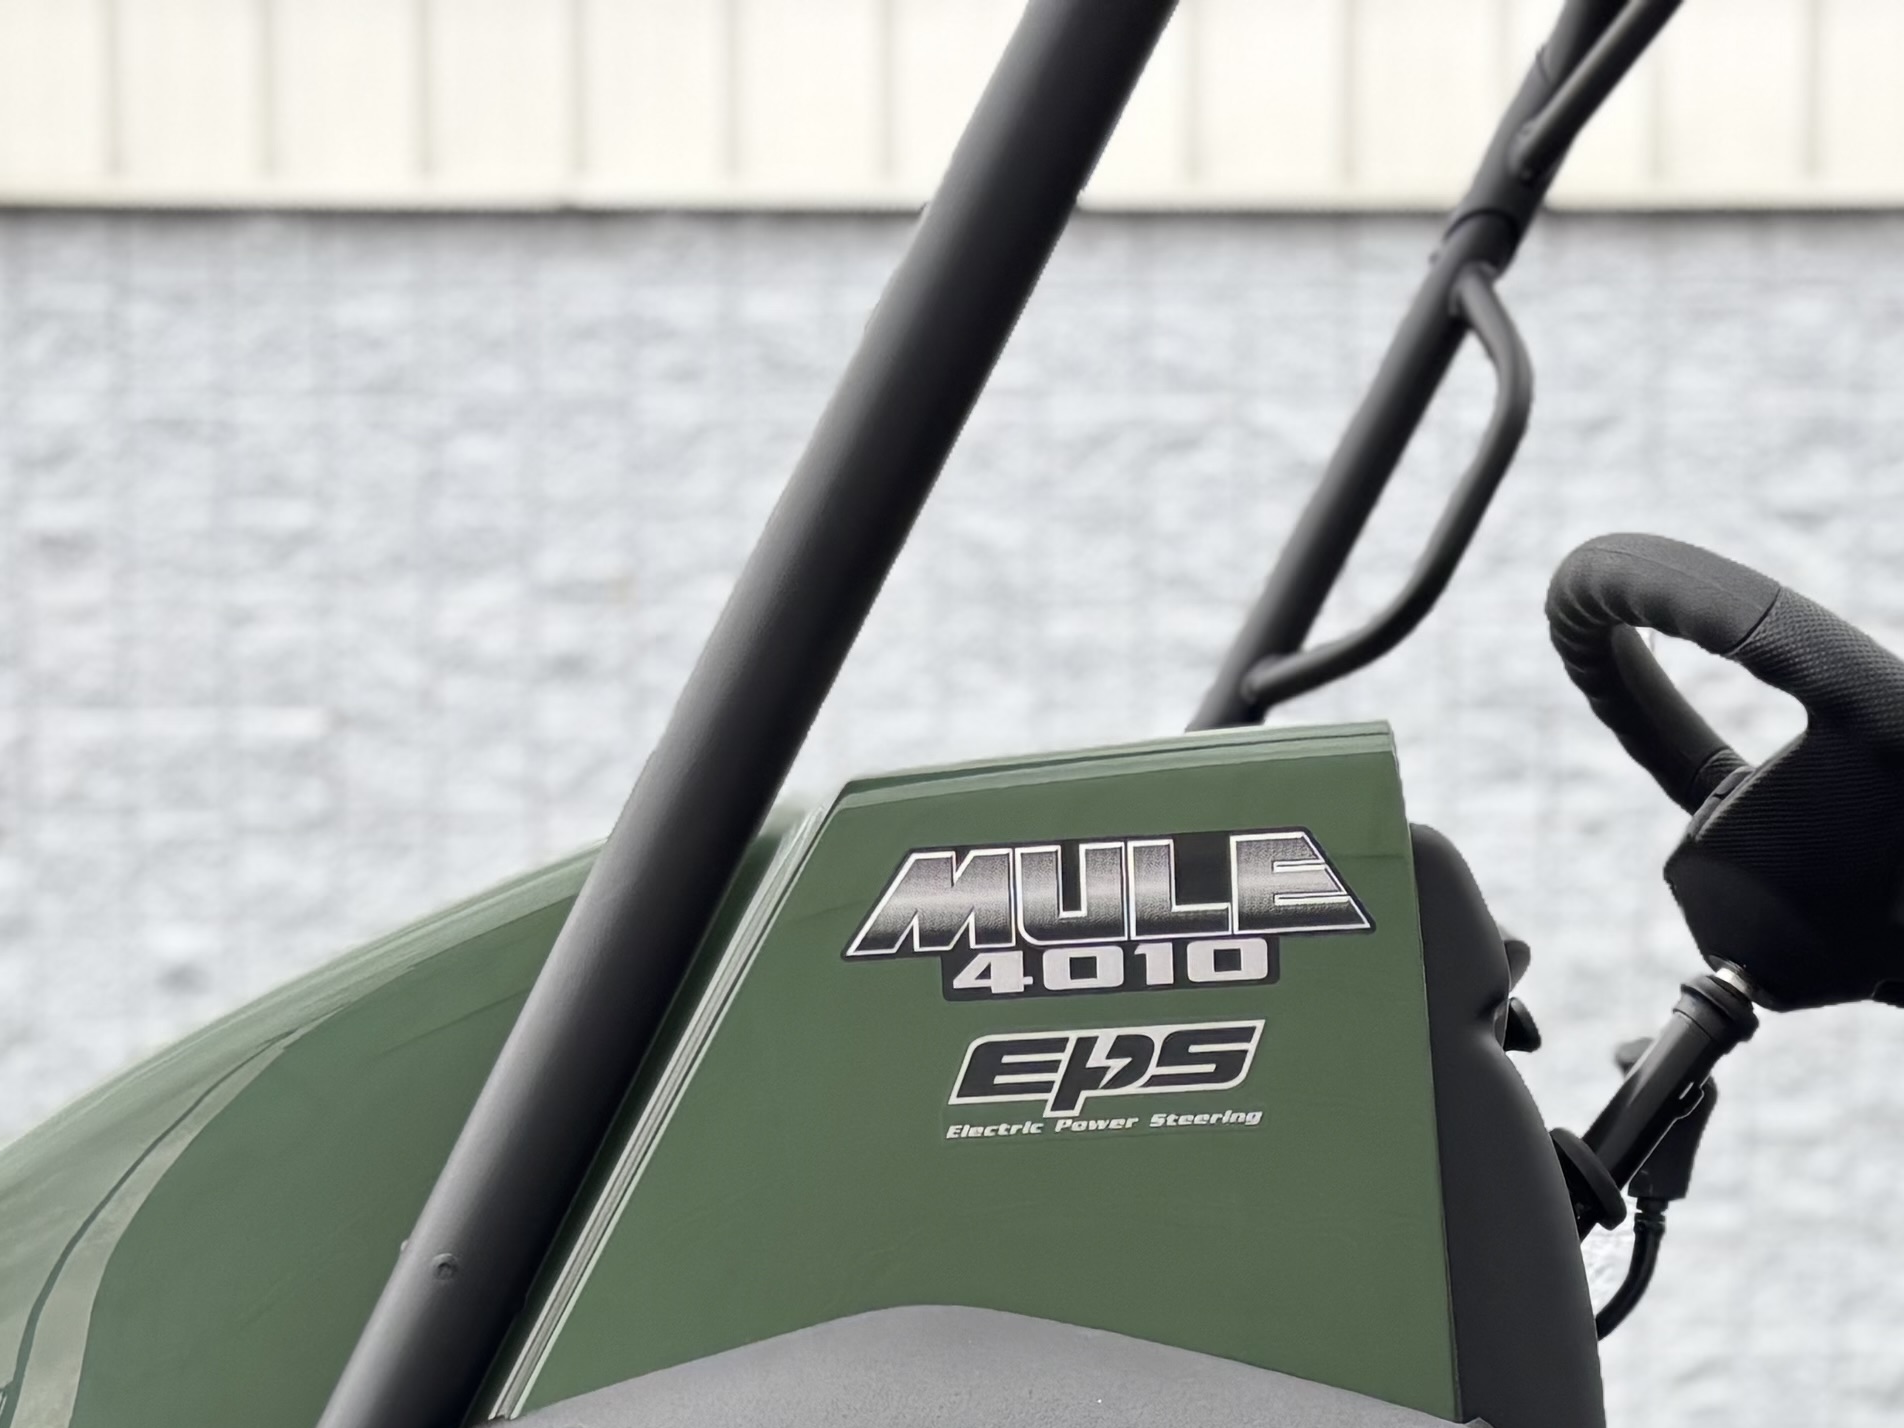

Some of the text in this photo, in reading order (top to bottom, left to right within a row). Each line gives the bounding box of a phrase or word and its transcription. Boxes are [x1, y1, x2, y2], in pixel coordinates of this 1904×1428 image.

[842, 828, 1375, 959] MULE
[953, 937, 1269, 994] 4010
[946, 1108, 1264, 1140] Electric Power Steering
